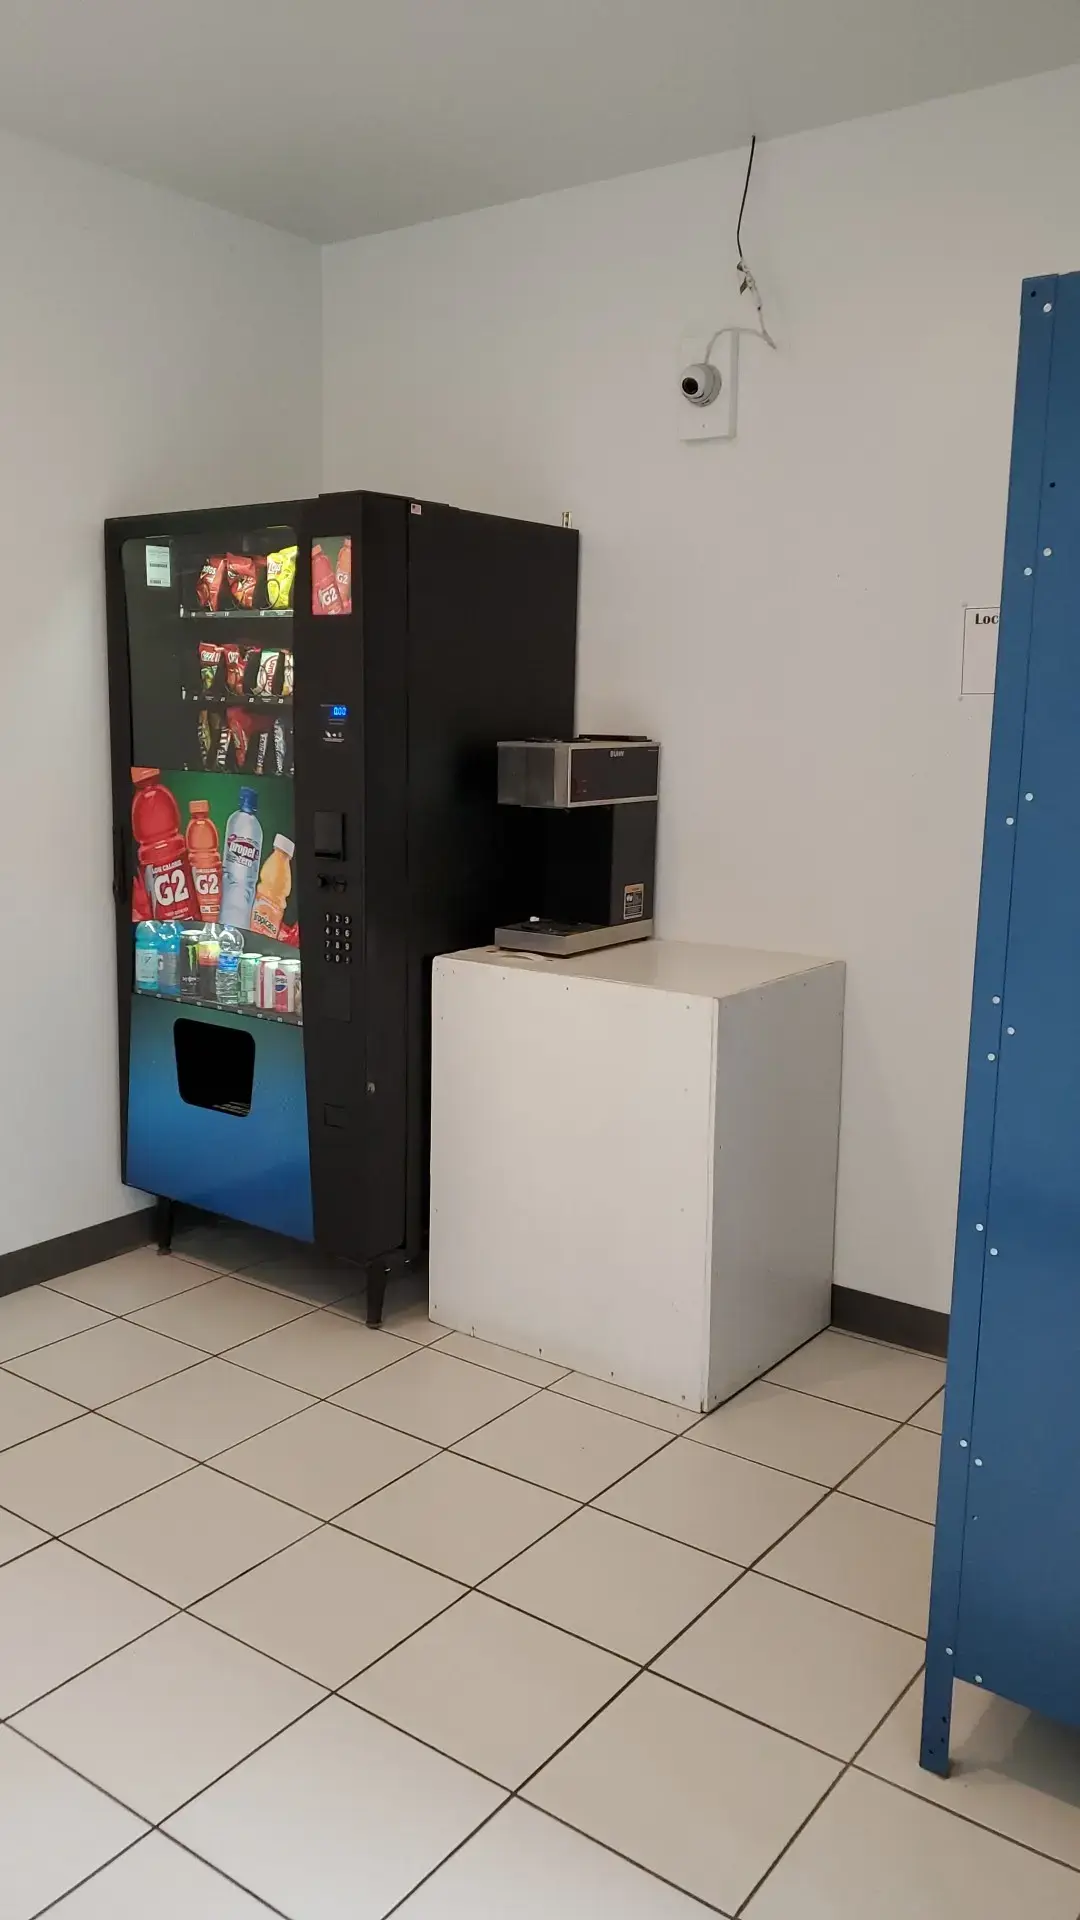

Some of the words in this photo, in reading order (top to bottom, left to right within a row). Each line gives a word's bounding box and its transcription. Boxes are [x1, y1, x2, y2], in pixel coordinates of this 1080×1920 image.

[337, 573, 348, 585] G2
[322, 587, 338, 606] G2
[229, 842, 256, 860] propel
[154, 869, 189, 906] G2
[195, 873, 219, 895] G2
[253, 911, 277, 935] Tropicana
